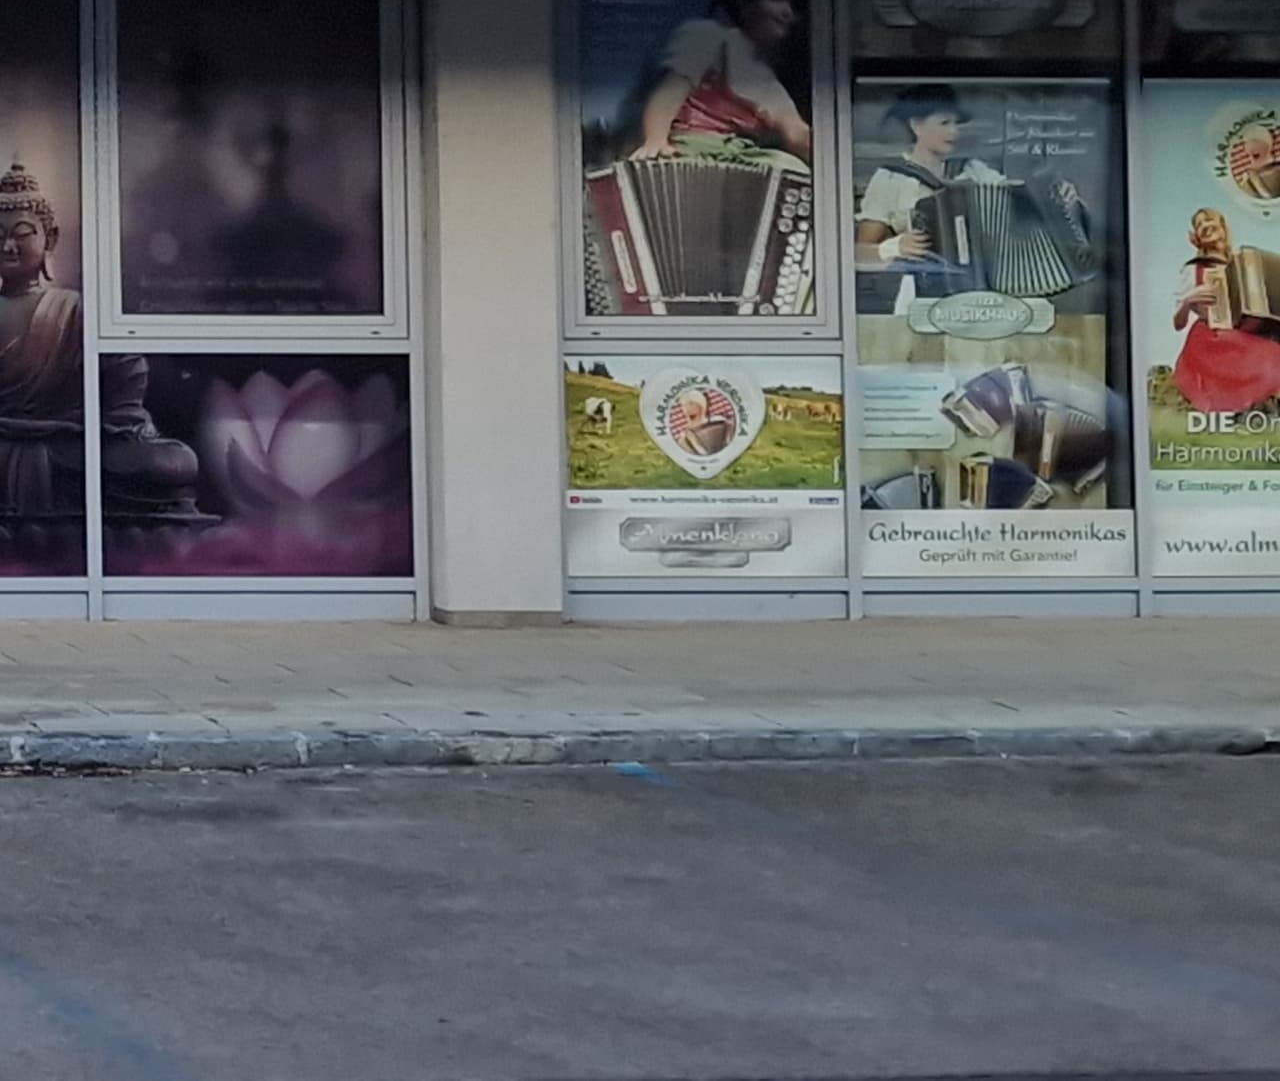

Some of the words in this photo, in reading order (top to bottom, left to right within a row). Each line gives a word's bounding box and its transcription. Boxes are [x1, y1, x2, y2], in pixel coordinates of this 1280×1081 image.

[1186, 410, 1237, 434] DIE
[1155, 440, 1280, 464] Harmonik
[1248, 478, 1259, 492] &
[867, 521, 993, 544] Gebrauchte
[998, 521, 1127, 544] Harmonikas
[919, 548, 977, 567] Geprüft
[981, 549, 1006, 562] mit
[1009, 548, 1079, 563] Garantie!
